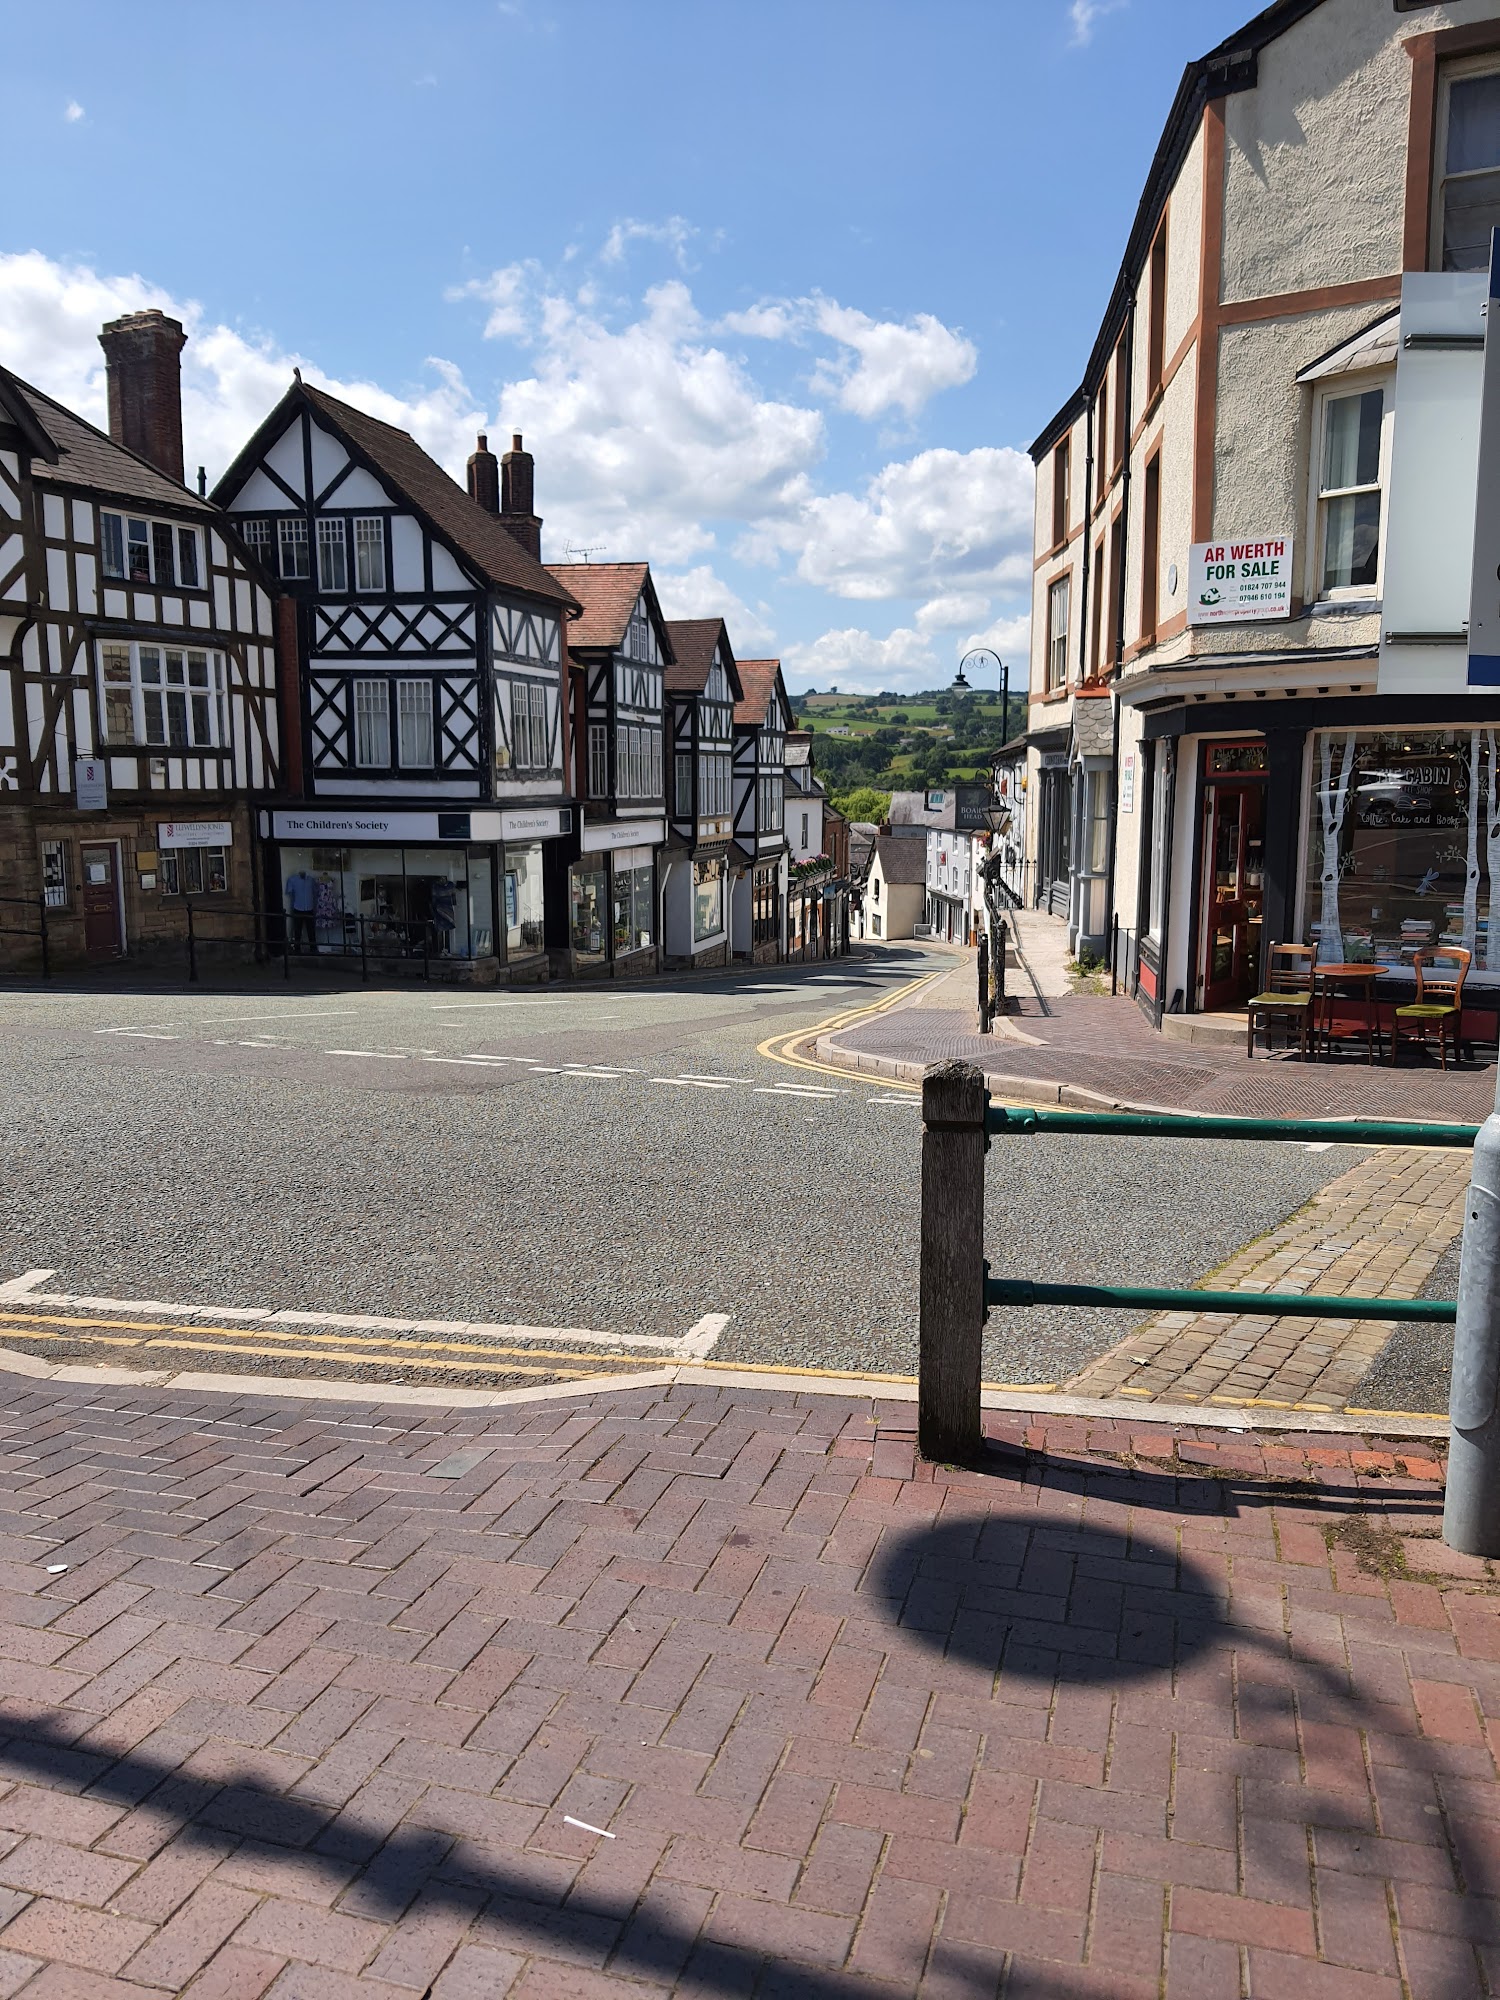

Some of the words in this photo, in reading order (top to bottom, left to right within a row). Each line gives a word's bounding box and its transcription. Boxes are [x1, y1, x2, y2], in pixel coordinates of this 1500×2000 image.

[1204, 547, 1225, 563] AR
[1230, 541, 1285, 561] WERTH
[1206, 564, 1236, 581] FOR
[1241, 560, 1280, 578] SALE
[1239, 584, 1259, 592] 01824
[1261, 582, 1273, 590] 707
[1274, 581, 1286, 589] 944
[1239, 594, 1259, 602] 07946
[1274, 592, 1286, 600] 194
[1405, 766, 1451, 785] CABIN
[1416, 786, 1433, 795] SHOP
[287, 820, 304, 830] The
[306, 820, 353, 830] Children's
[355, 821, 389, 832] Society
[509, 821, 517, 830] The
[517, 820, 536, 829] Children's
[536, 819, 549, 829] Society
[1391, 812, 1411, 824] Cake
[1414, 815, 1430, 824] and
[1436, 814, 1461, 829] Books
